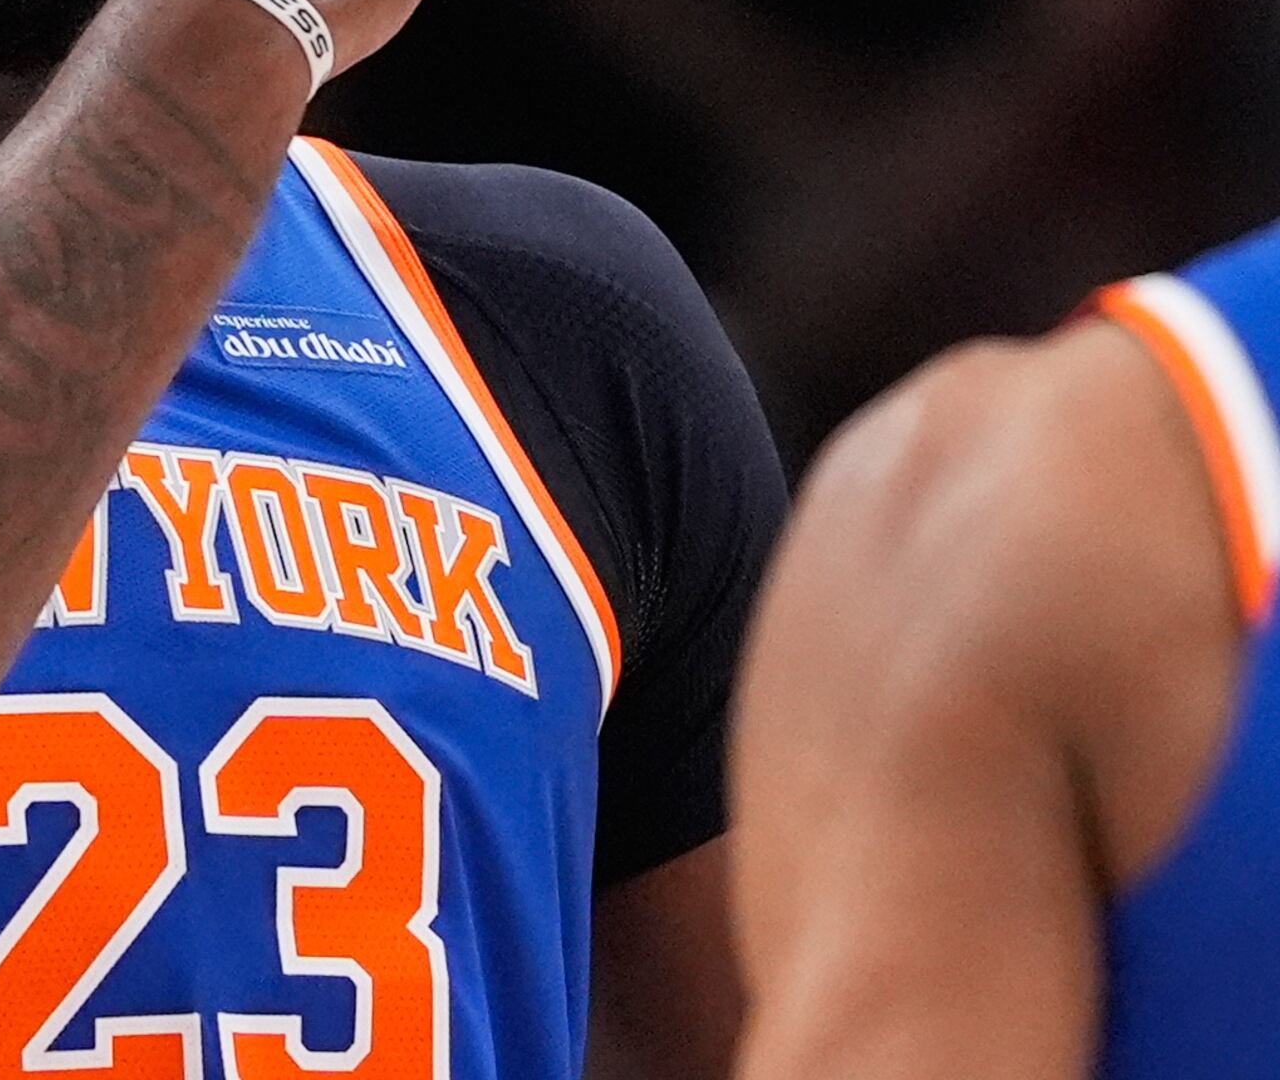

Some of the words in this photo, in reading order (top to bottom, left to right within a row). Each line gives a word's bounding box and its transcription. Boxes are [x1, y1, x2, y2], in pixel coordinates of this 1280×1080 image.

[213, 313, 311, 330] experience
[223, 330, 299, 359] abu
[298, 332, 407, 368] dhabi
[119, 442, 539, 700] YORK
